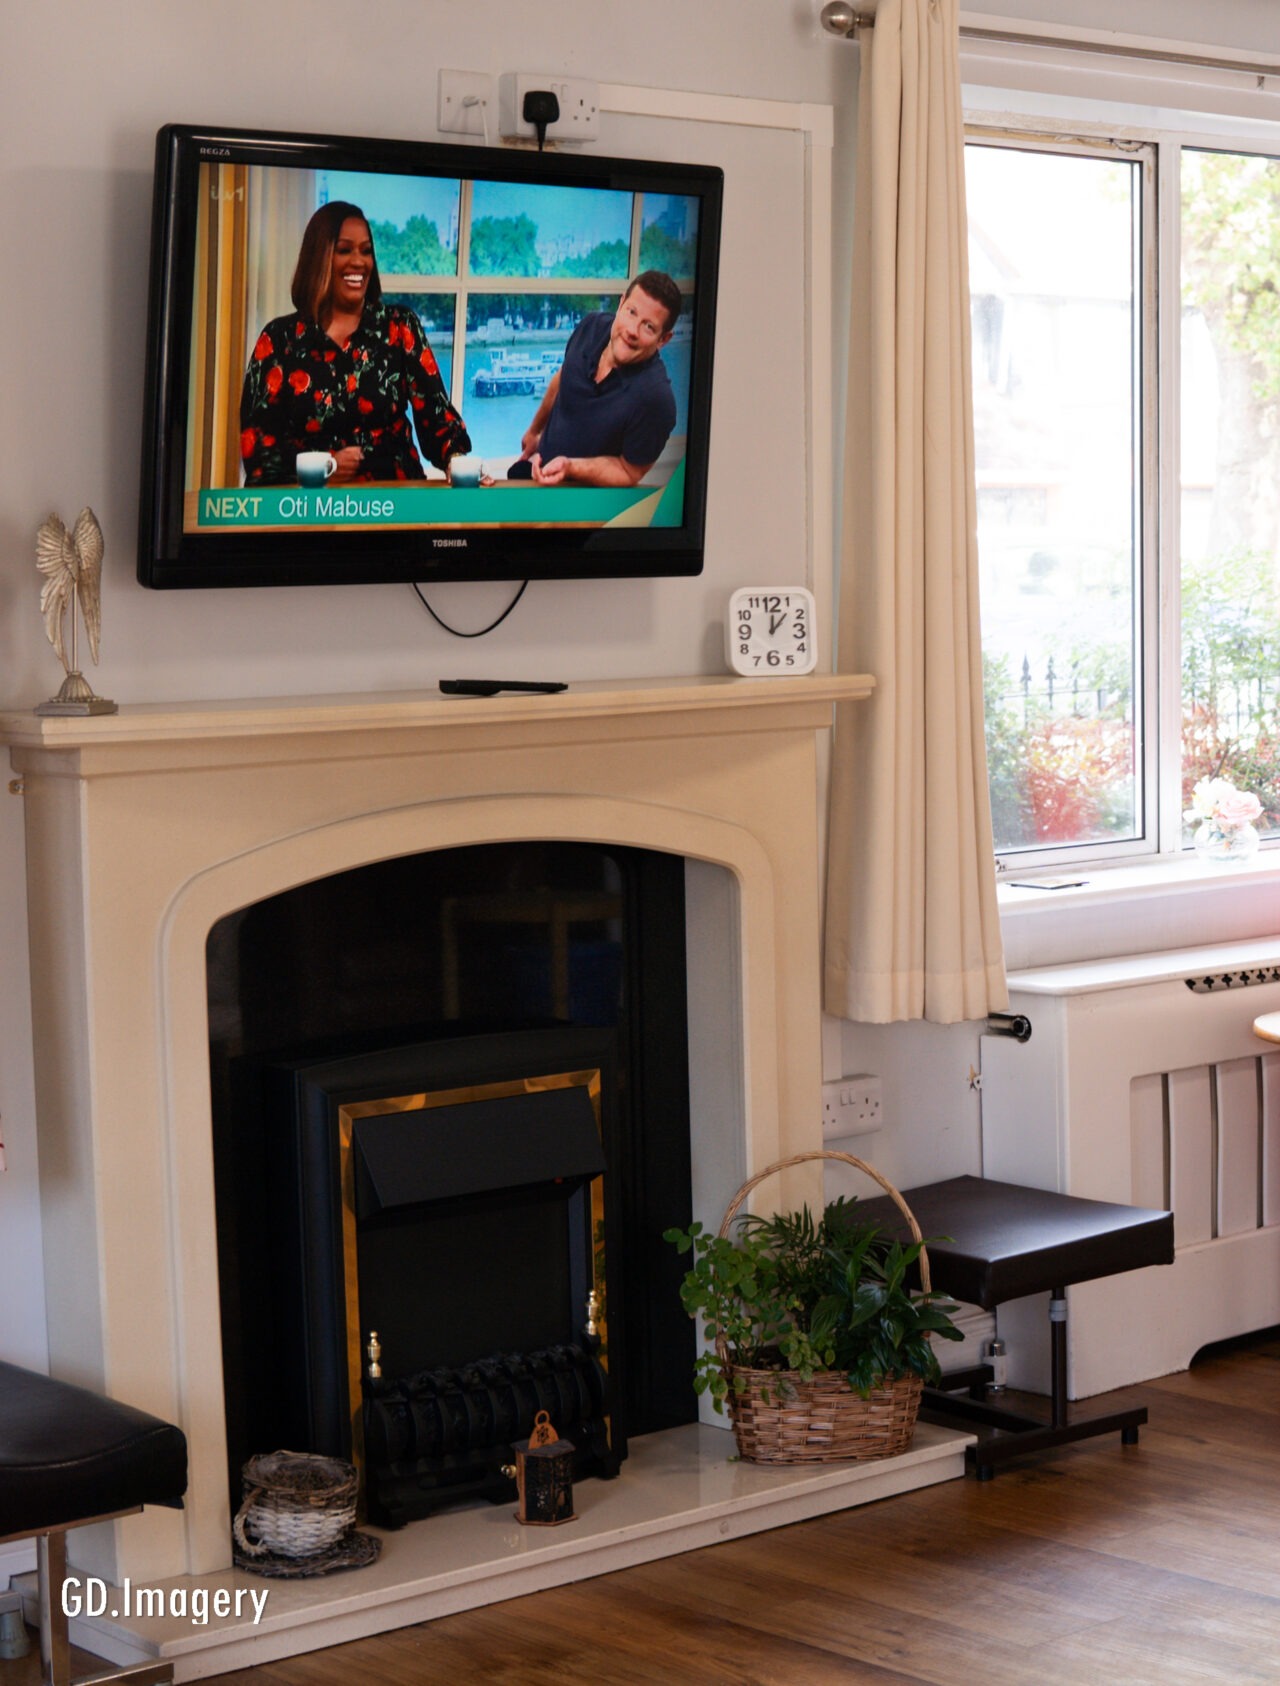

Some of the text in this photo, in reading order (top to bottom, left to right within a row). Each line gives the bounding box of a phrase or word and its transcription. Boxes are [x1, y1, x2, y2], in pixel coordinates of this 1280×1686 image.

[200, 147, 231, 156] REGZA
[205, 495, 395, 518] NEXT Oti Mabuse
[432, 539, 468, 547] TOSHIBA
[748, 597, 760, 608] 11
[762, 596, 781, 613] 12
[785, 596, 790, 607] 1
[738, 610, 751, 621] 10
[795, 609, 805, 620] 2
[738, 624, 752, 640] 9
[793, 623, 806, 639] 3
[740, 643, 749, 655] 8
[796, 642, 806, 653] 4
[752, 655, 762, 667] 7
[766, 650, 781, 666] 6
[785, 655, 795, 666] 5
